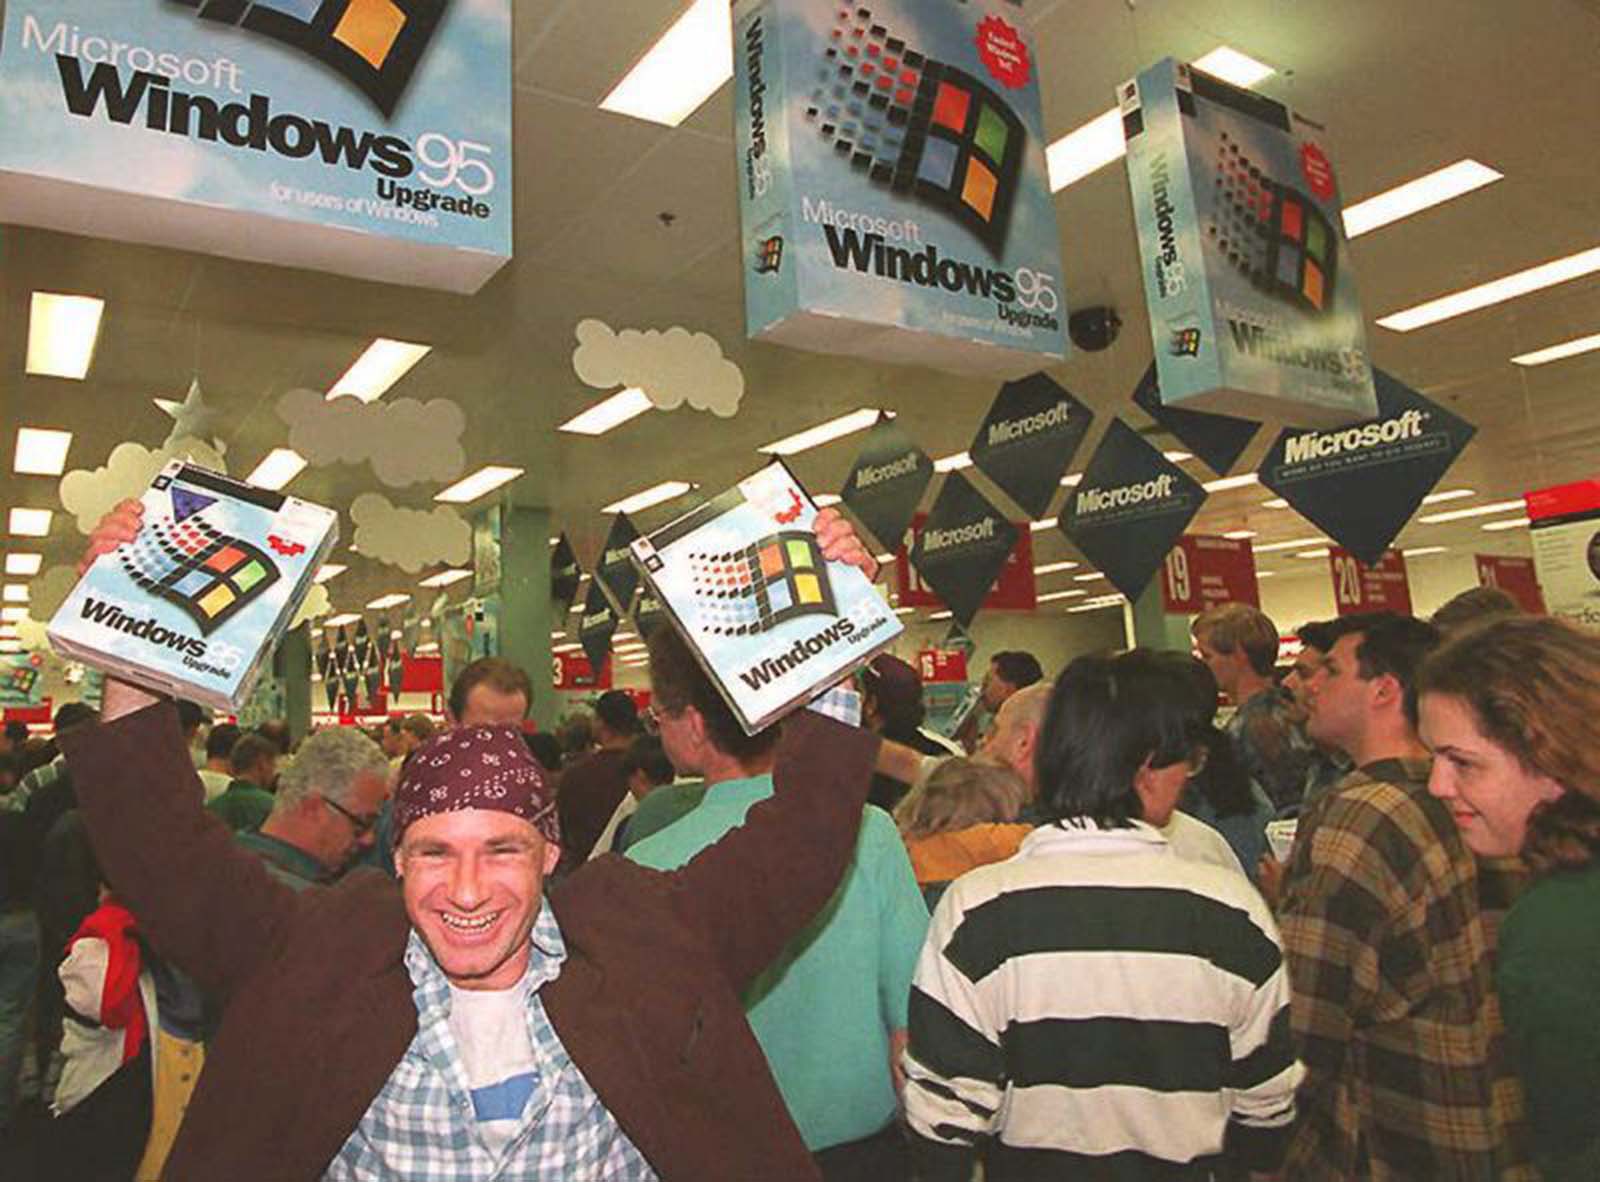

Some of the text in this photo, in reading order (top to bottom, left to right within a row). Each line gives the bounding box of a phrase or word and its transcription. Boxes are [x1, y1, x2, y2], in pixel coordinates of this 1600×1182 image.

[21, 15, 244, 94] Microsoft
[746, 16, 766, 159] Windows
[56, 53, 494, 194] Windows 95
[377, 178, 490, 218] Upgrade
[802, 196, 921, 244] Microsoft
[1151, 153, 1177, 267] Windows
[823, 223, 1058, 313] Windows 95
[998, 303, 1058, 331] Upgrade
[988, 401, 1068, 446] Microsoft
[1285, 409, 1423, 465] Microsoft
[856, 453, 918, 489] Microsoft
[1076, 473, 1172, 515] Microsoft
[923, 516, 994, 551] Microsoft
[1165, 546, 1190, 601] 19
[1335, 556, 1360, 605] 20
[80, 598, 208, 658] Windows
[739, 617, 855, 691] Windows
[182, 656, 231, 680] Upgrade
